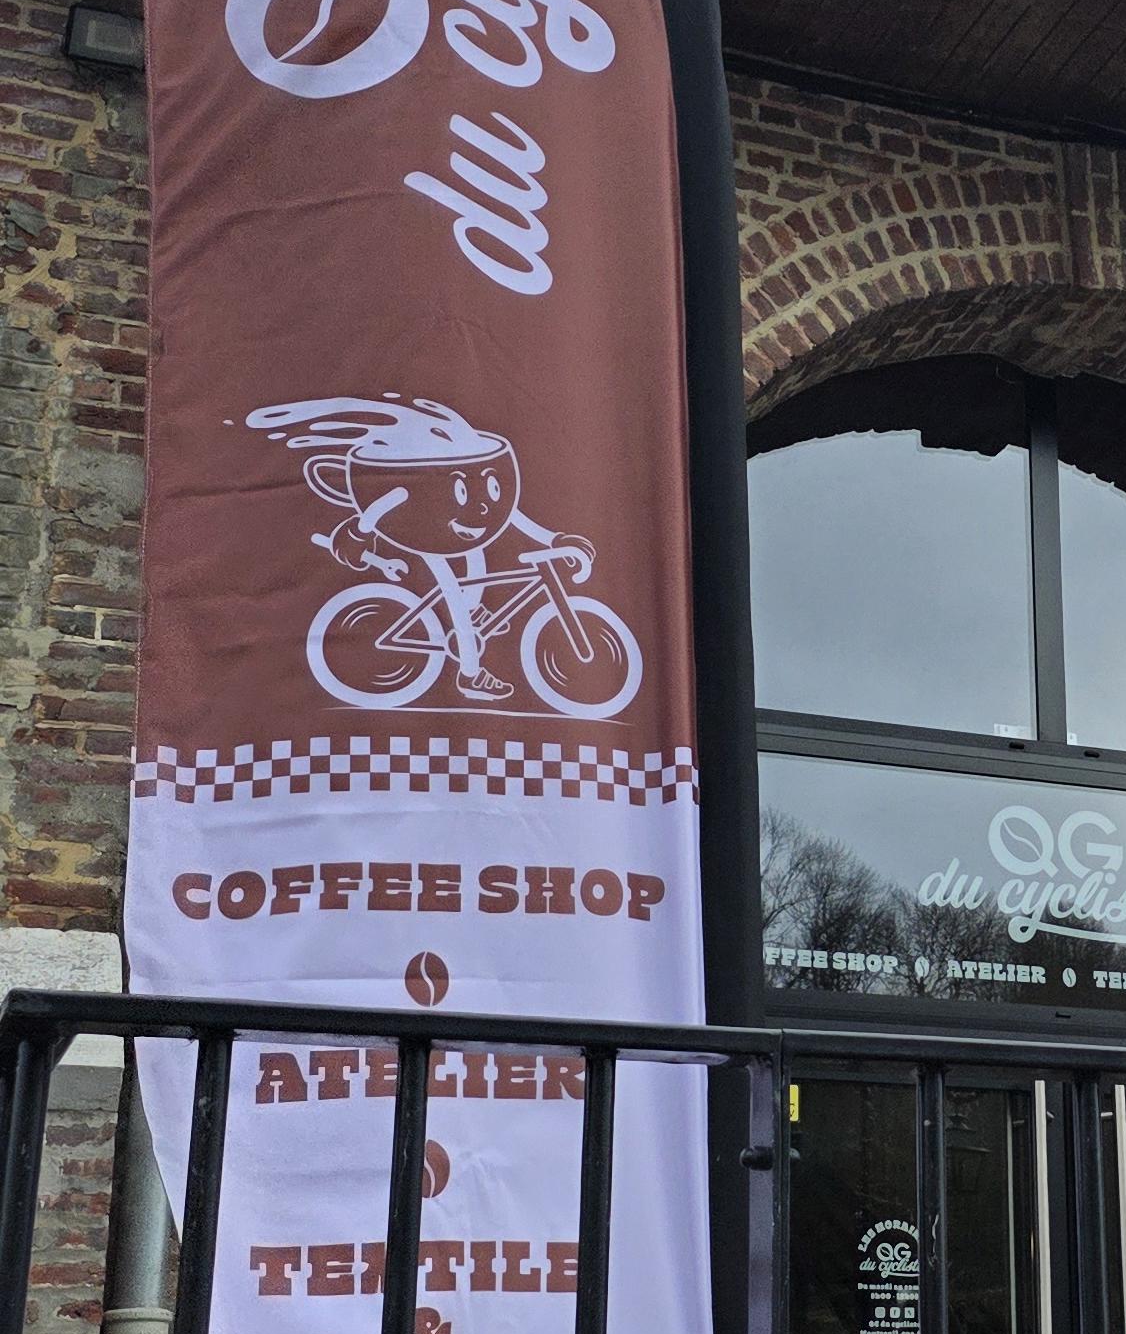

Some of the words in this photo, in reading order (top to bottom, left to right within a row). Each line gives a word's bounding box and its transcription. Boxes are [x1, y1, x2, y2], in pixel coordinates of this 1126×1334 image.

[405, 111, 553, 295] du
[988, 805, 1123, 879] QG
[172, 862, 462, 921] COFFEE
[477, 865, 666, 921] SHOP
[918, 857, 988, 910] du
[765, 947, 828, 969] FFEE
[832, 952, 899, 974] SHOP
[946, 960, 1046, 984] ATELIER
[255, 1049, 586, 1104] ATELIER
[859, 1257, 876, 1271] du
[878, 1257, 920, 1278] cyclist
[876, 1242, 911, 1262] QG
